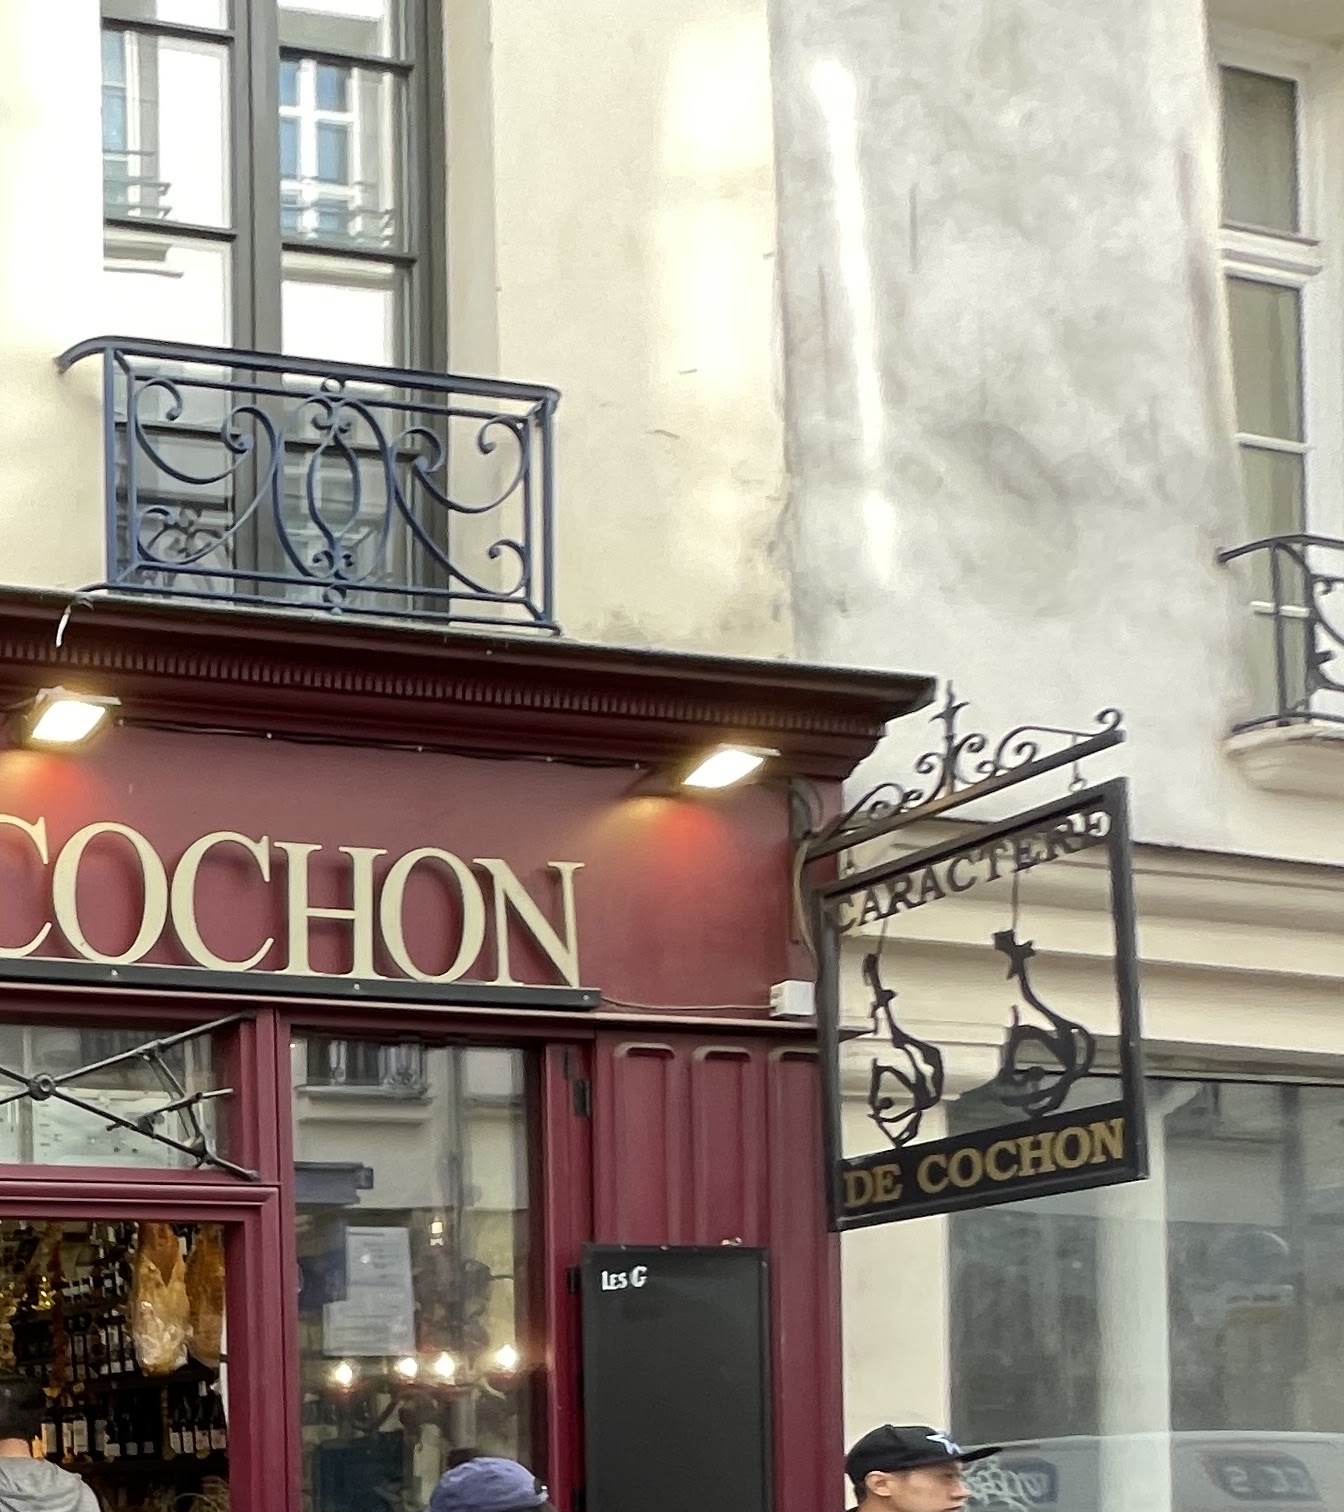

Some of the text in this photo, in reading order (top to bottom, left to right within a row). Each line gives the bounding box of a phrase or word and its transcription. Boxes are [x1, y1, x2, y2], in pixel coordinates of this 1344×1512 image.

[835, 810, 1112, 934] CARACTERE
[844, 1117, 1126, 1208] DE COCHON
[629, 1265, 648, 1288] G
